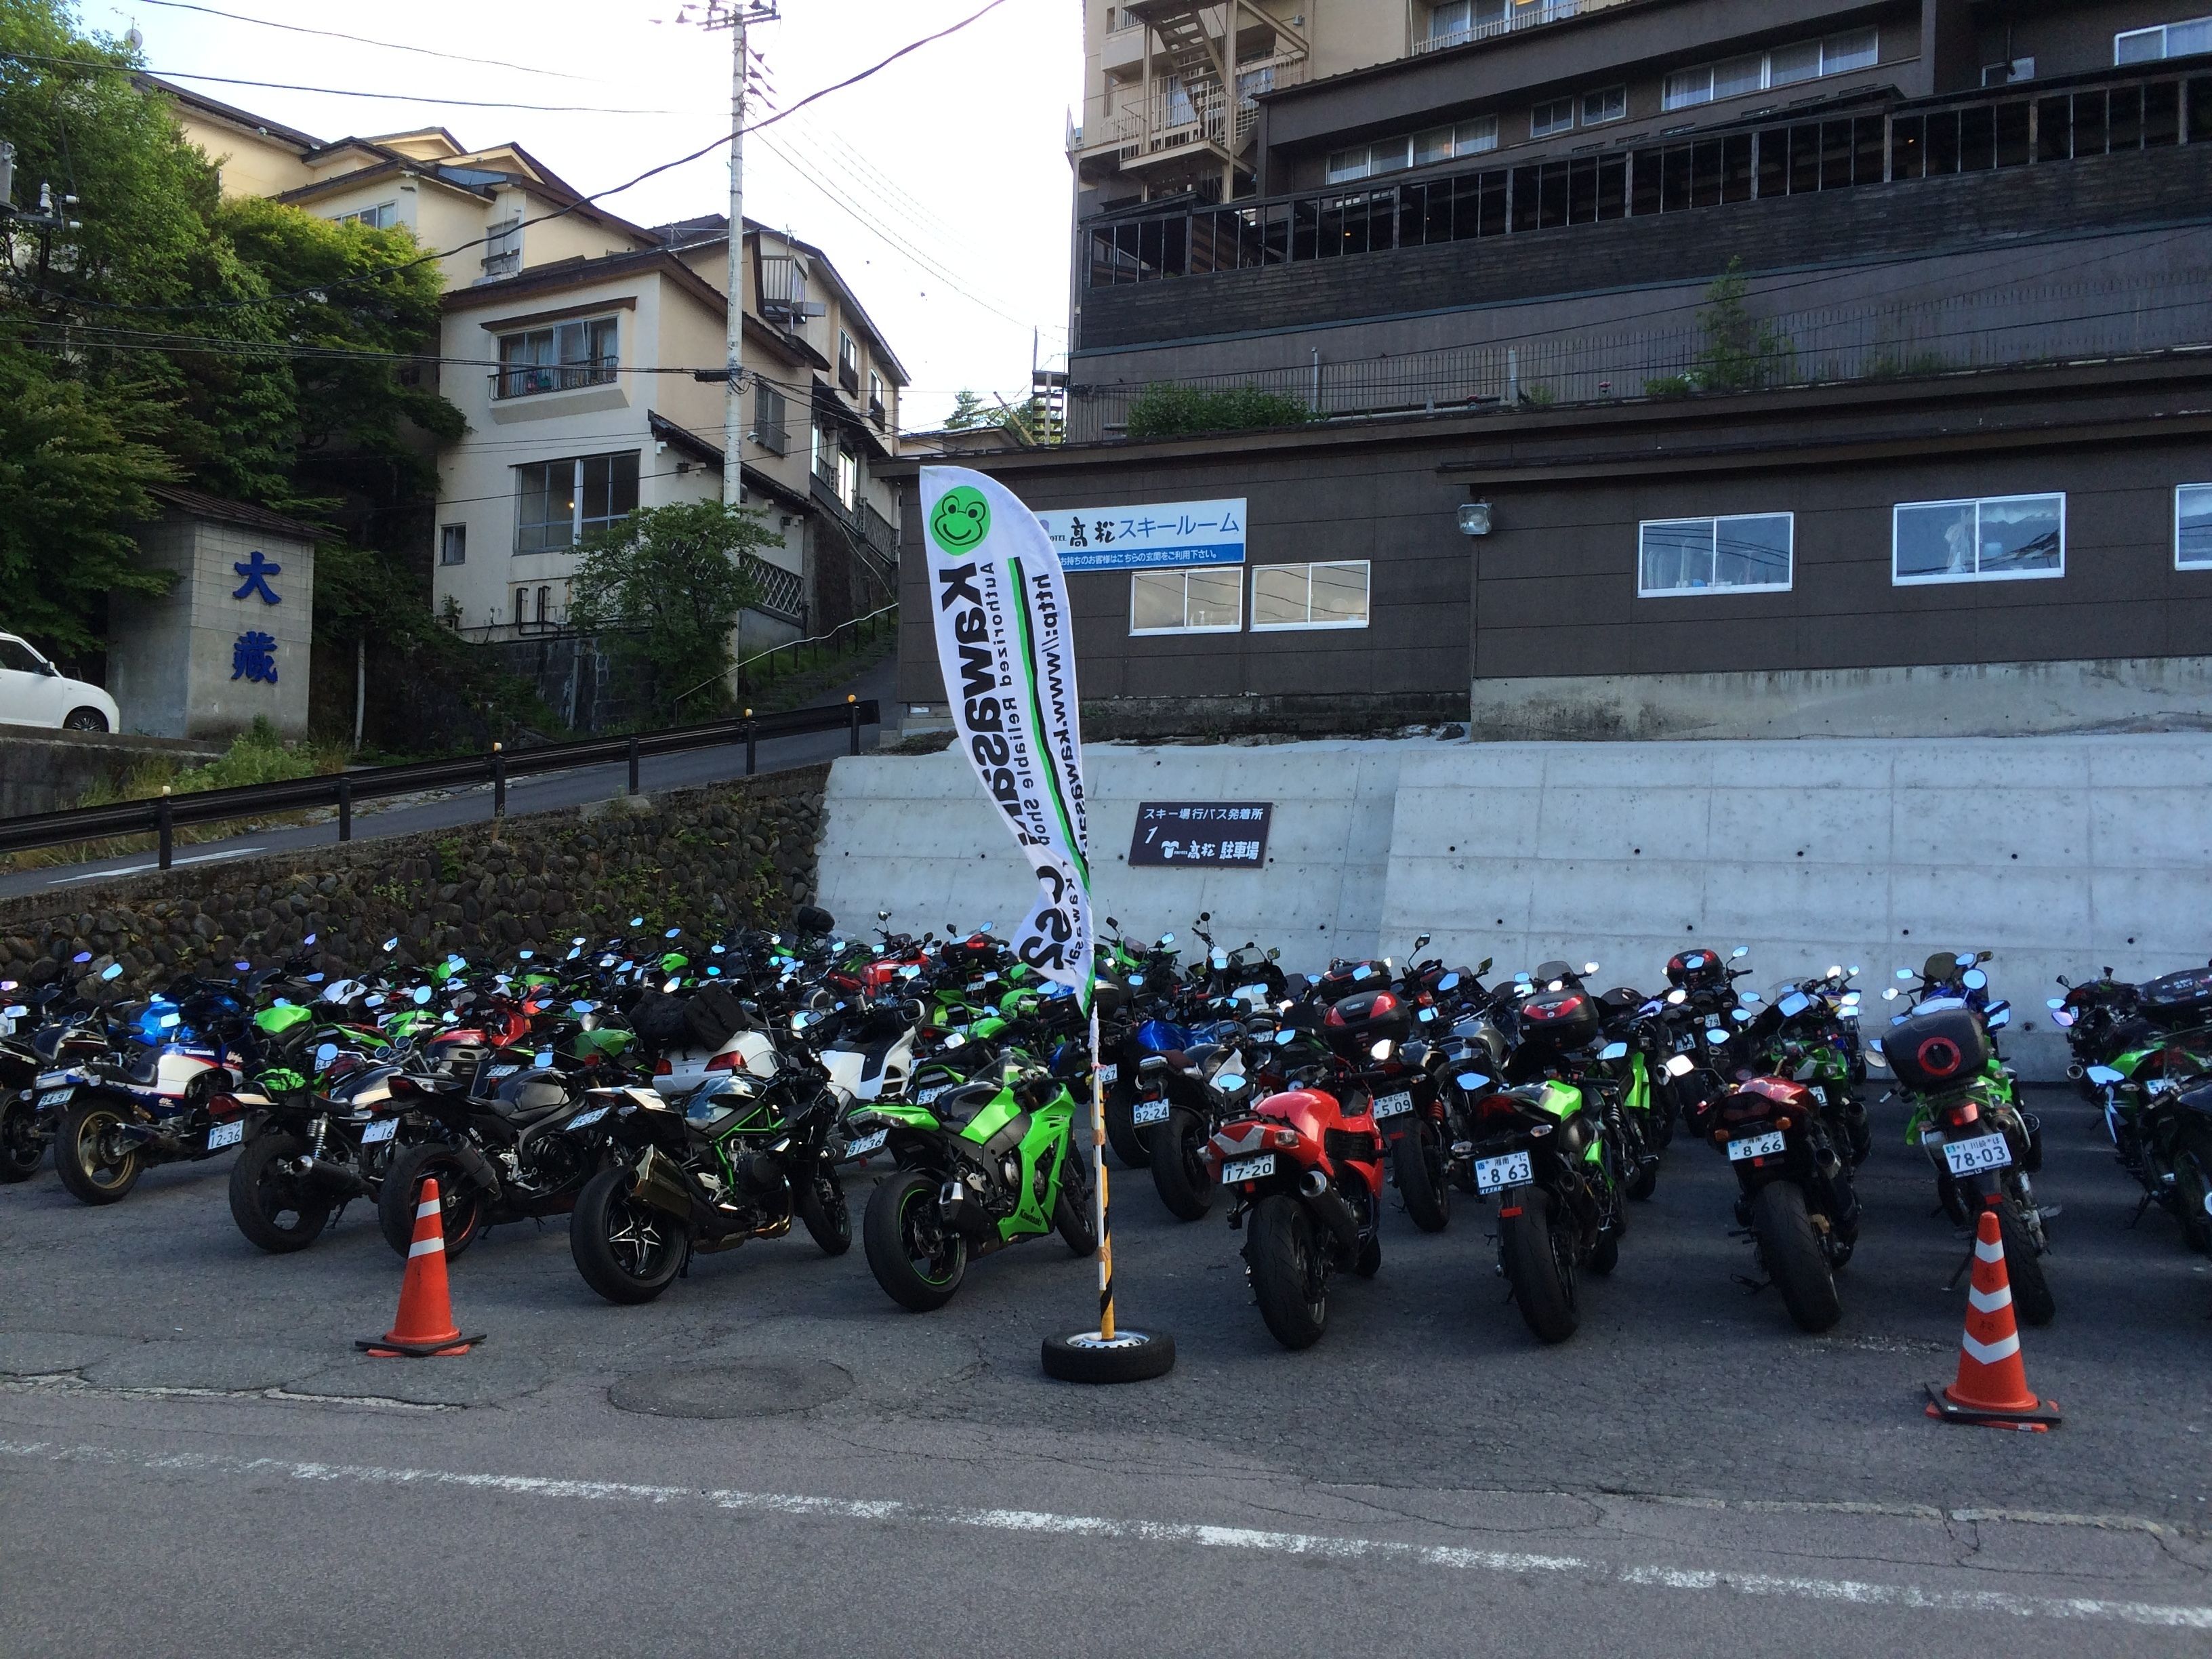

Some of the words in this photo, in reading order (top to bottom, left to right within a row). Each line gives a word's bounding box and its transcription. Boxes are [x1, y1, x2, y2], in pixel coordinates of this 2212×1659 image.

[1144, 808, 1264, 820] スキー場行バス発着所
[1145, 825, 1159, 844] 1
[1219, 841, 1260, 860] 駐車場
[1136, 1107, 1168, 1122] 92-24
[211, 1129, 240, 1148] 12-36
[848, 1136, 883, 1156] 91-36
[1951, 1146, 2006, 1170] 78-03
[1227, 1163, 1272, 1182] 17-20
[1019, 1208, 1043, 1227] Kawasaki
